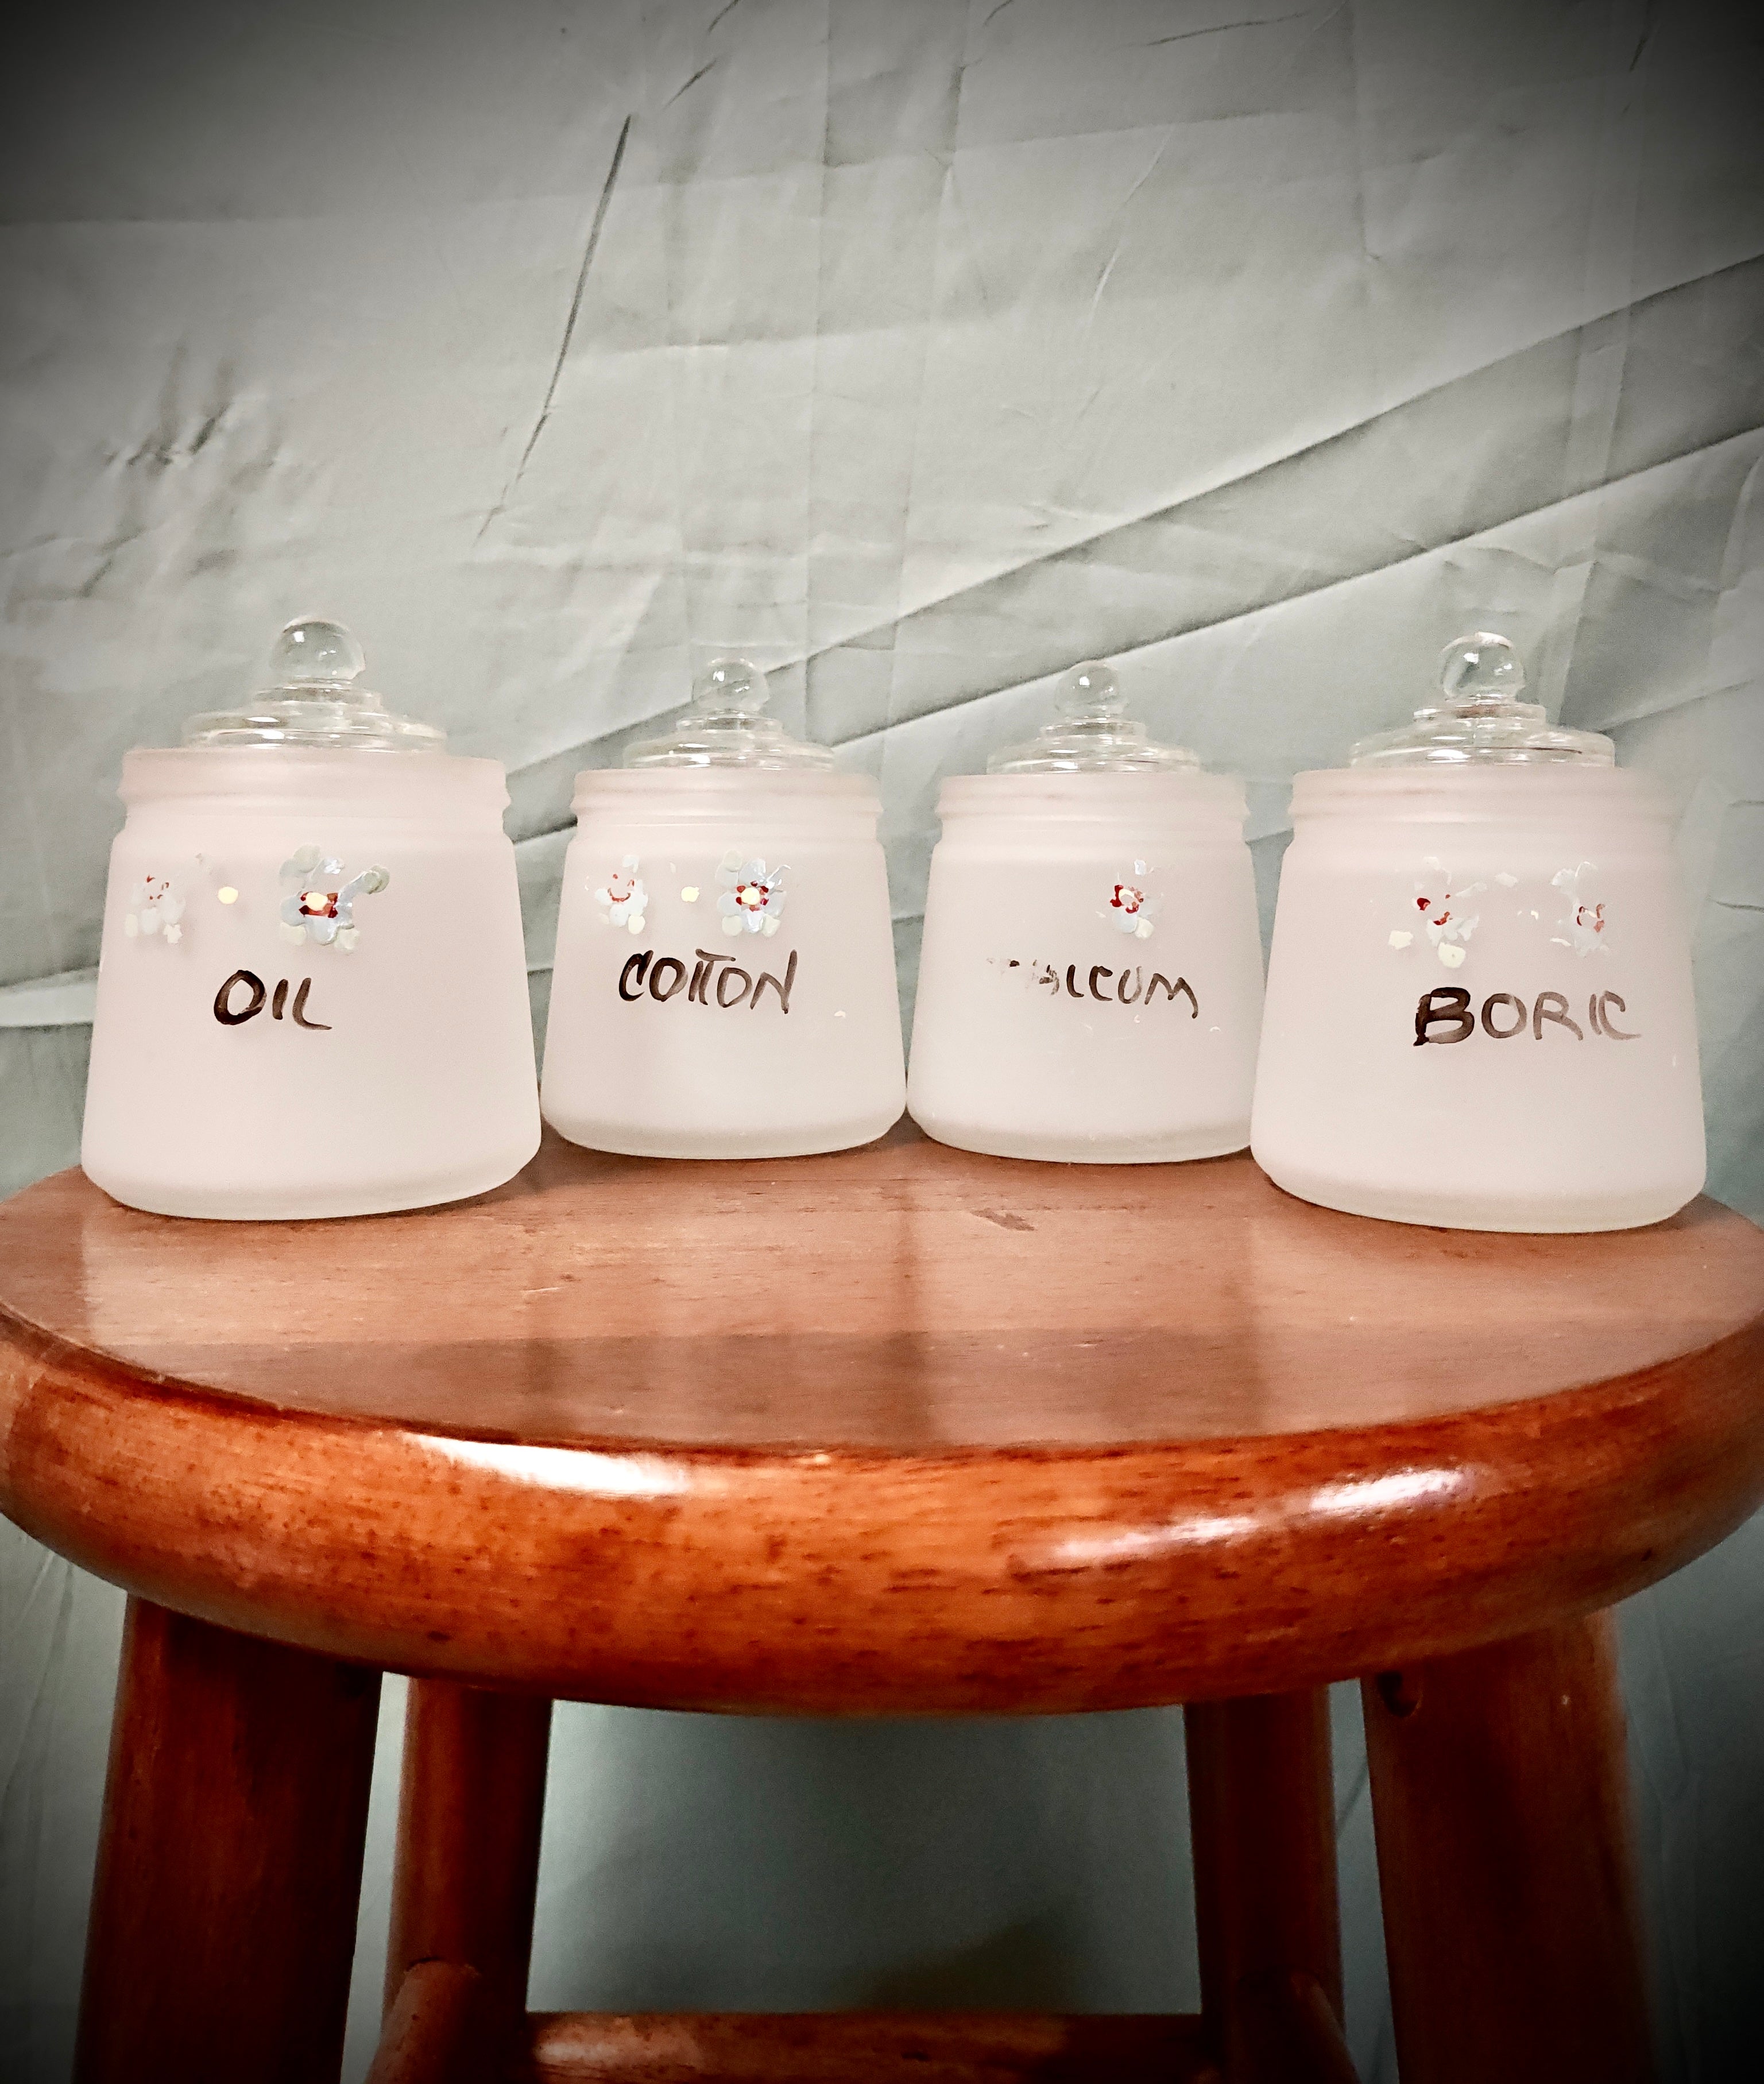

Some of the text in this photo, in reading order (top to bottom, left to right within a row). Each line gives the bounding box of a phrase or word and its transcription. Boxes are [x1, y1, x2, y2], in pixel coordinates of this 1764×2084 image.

[214, 969, 332, 1030] OIL
[618, 948, 798, 1015] COTTON
[986, 958, 1199, 1019] ALCUM
[1413, 986, 1642, 1046] BORIC
